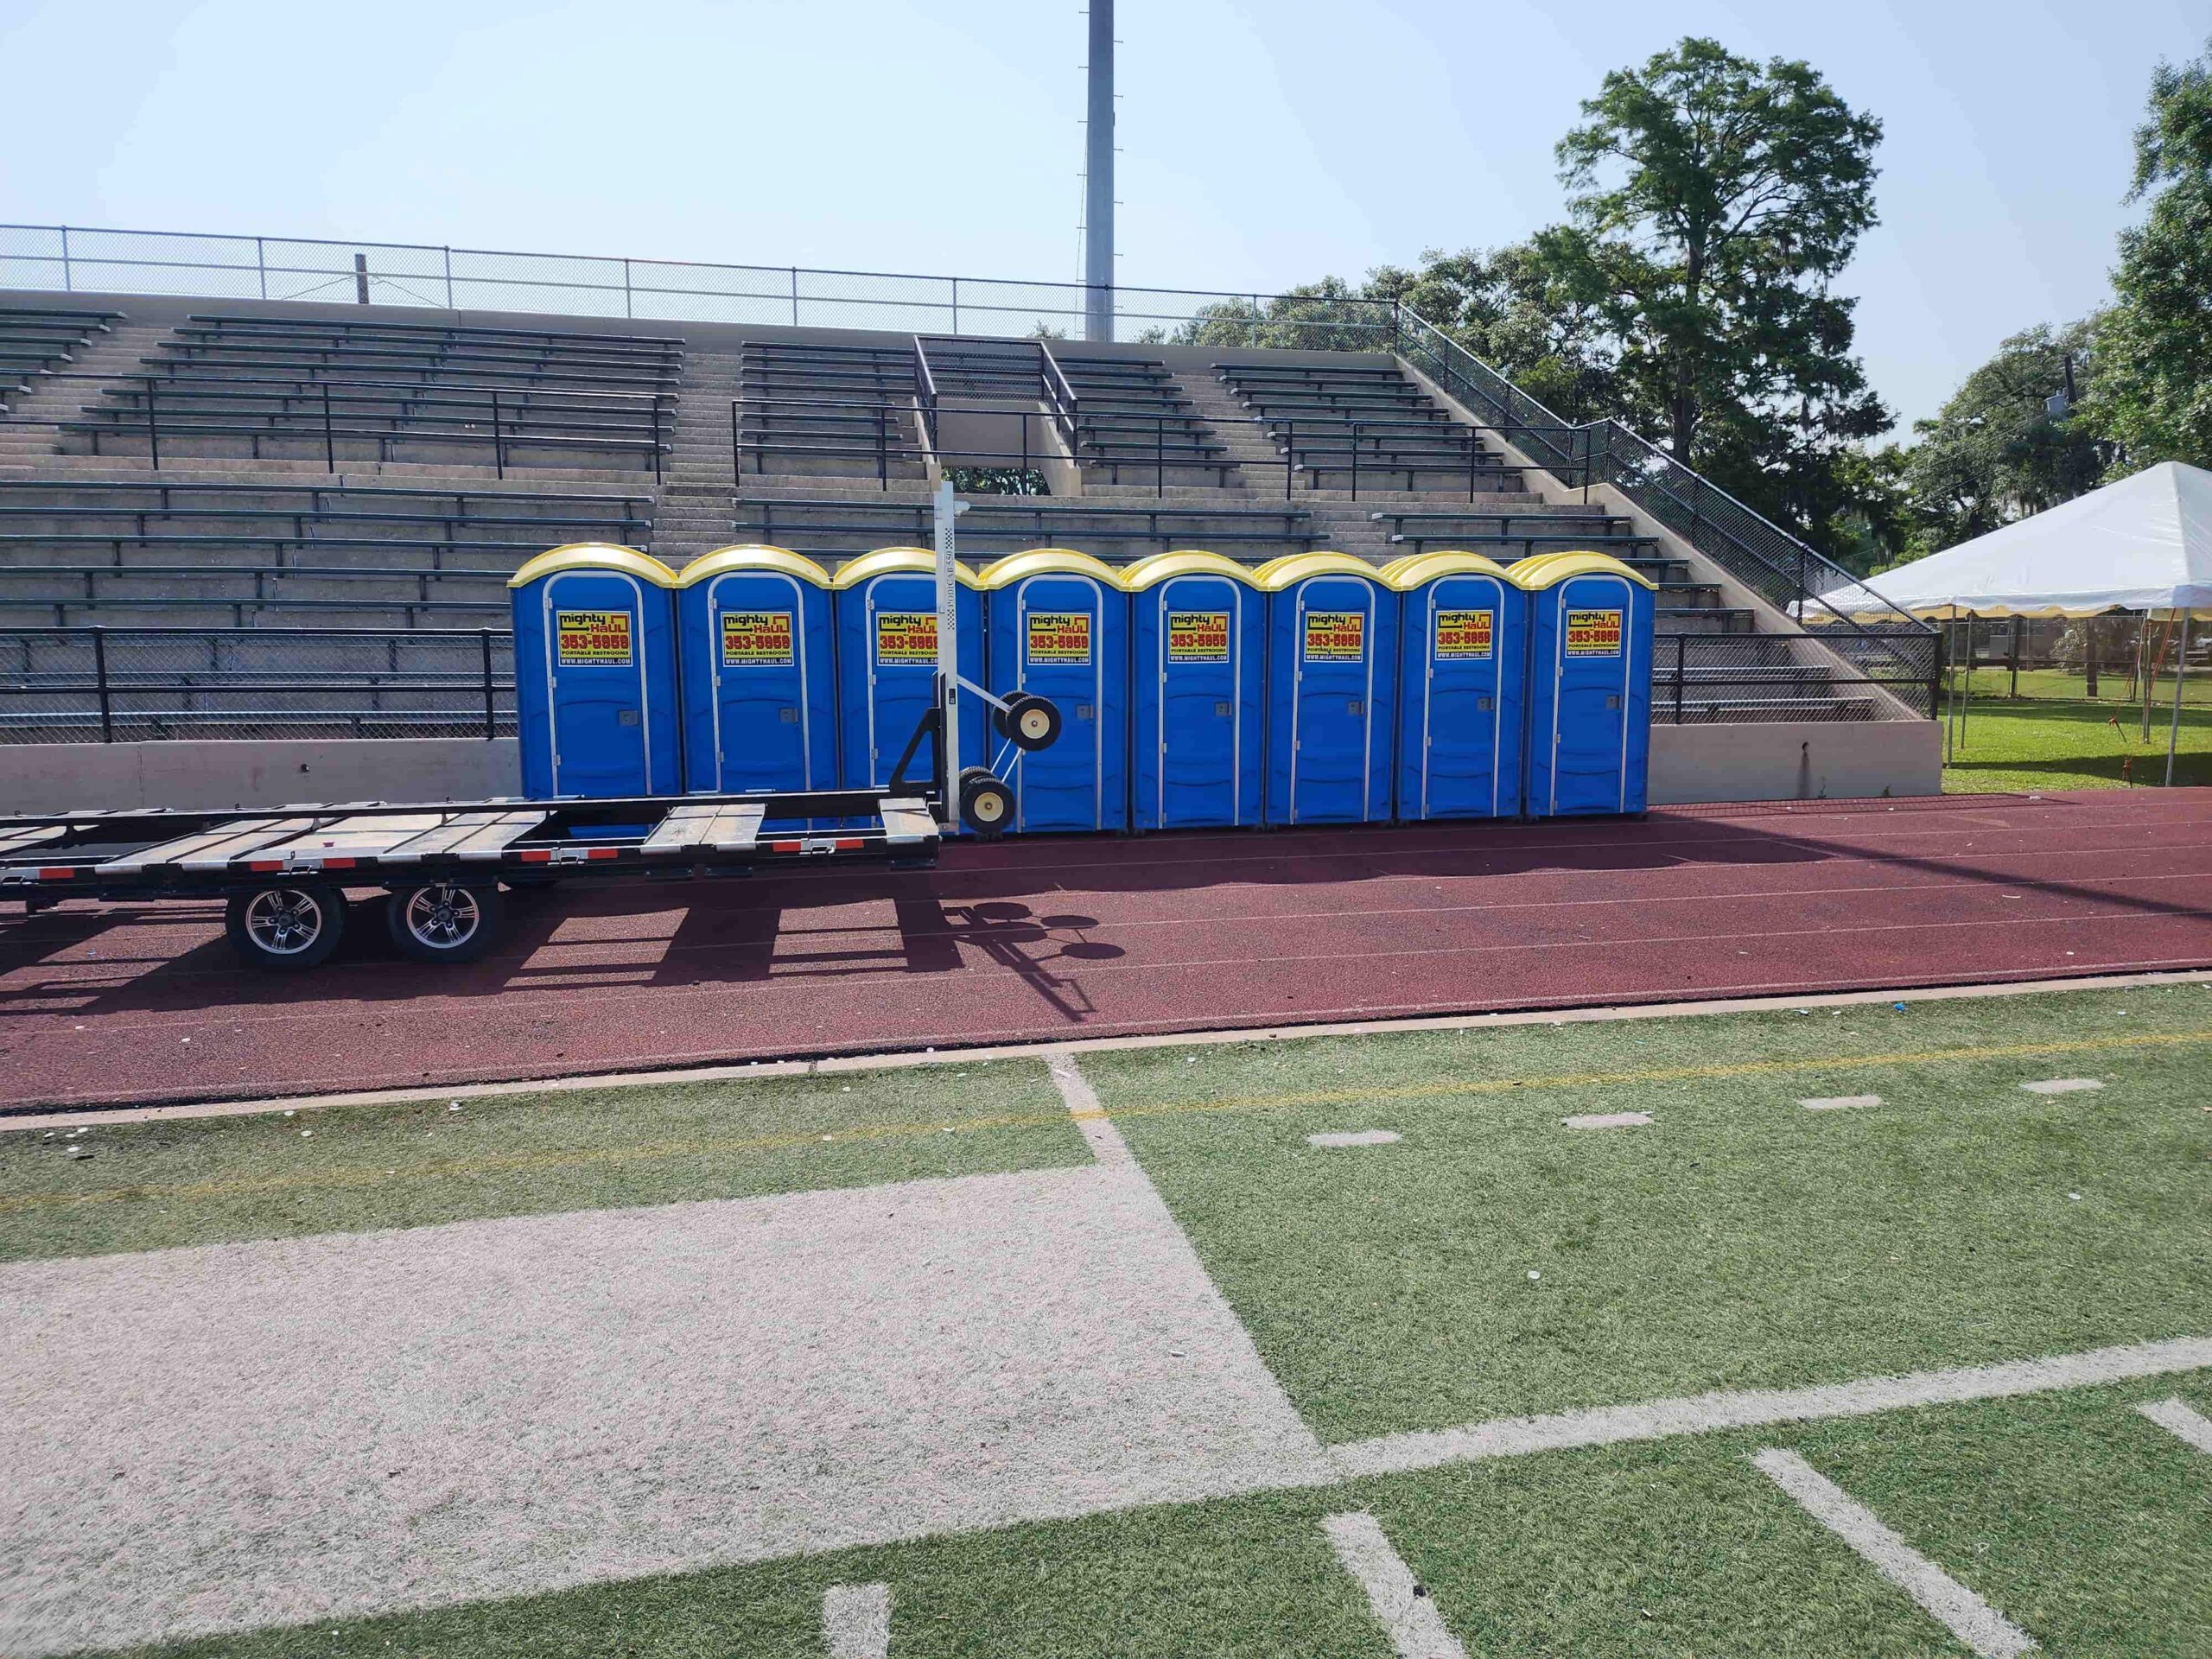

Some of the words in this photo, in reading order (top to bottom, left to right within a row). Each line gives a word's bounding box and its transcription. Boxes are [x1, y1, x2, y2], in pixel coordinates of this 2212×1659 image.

[560, 614, 606, 625] mighty
[724, 615, 768, 626] mighty
[879, 615, 921, 626] mighty
[1029, 616, 1070, 626] mighty
[1171, 615, 1210, 625] mighty
[1307, 615, 1345, 625] mighty
[1439, 613, 1475, 623] mighty
[1569, 613, 1605, 622] mighty
[561, 635, 629, 649] 353-5959
[726, 635, 790, 649] 353-5959
